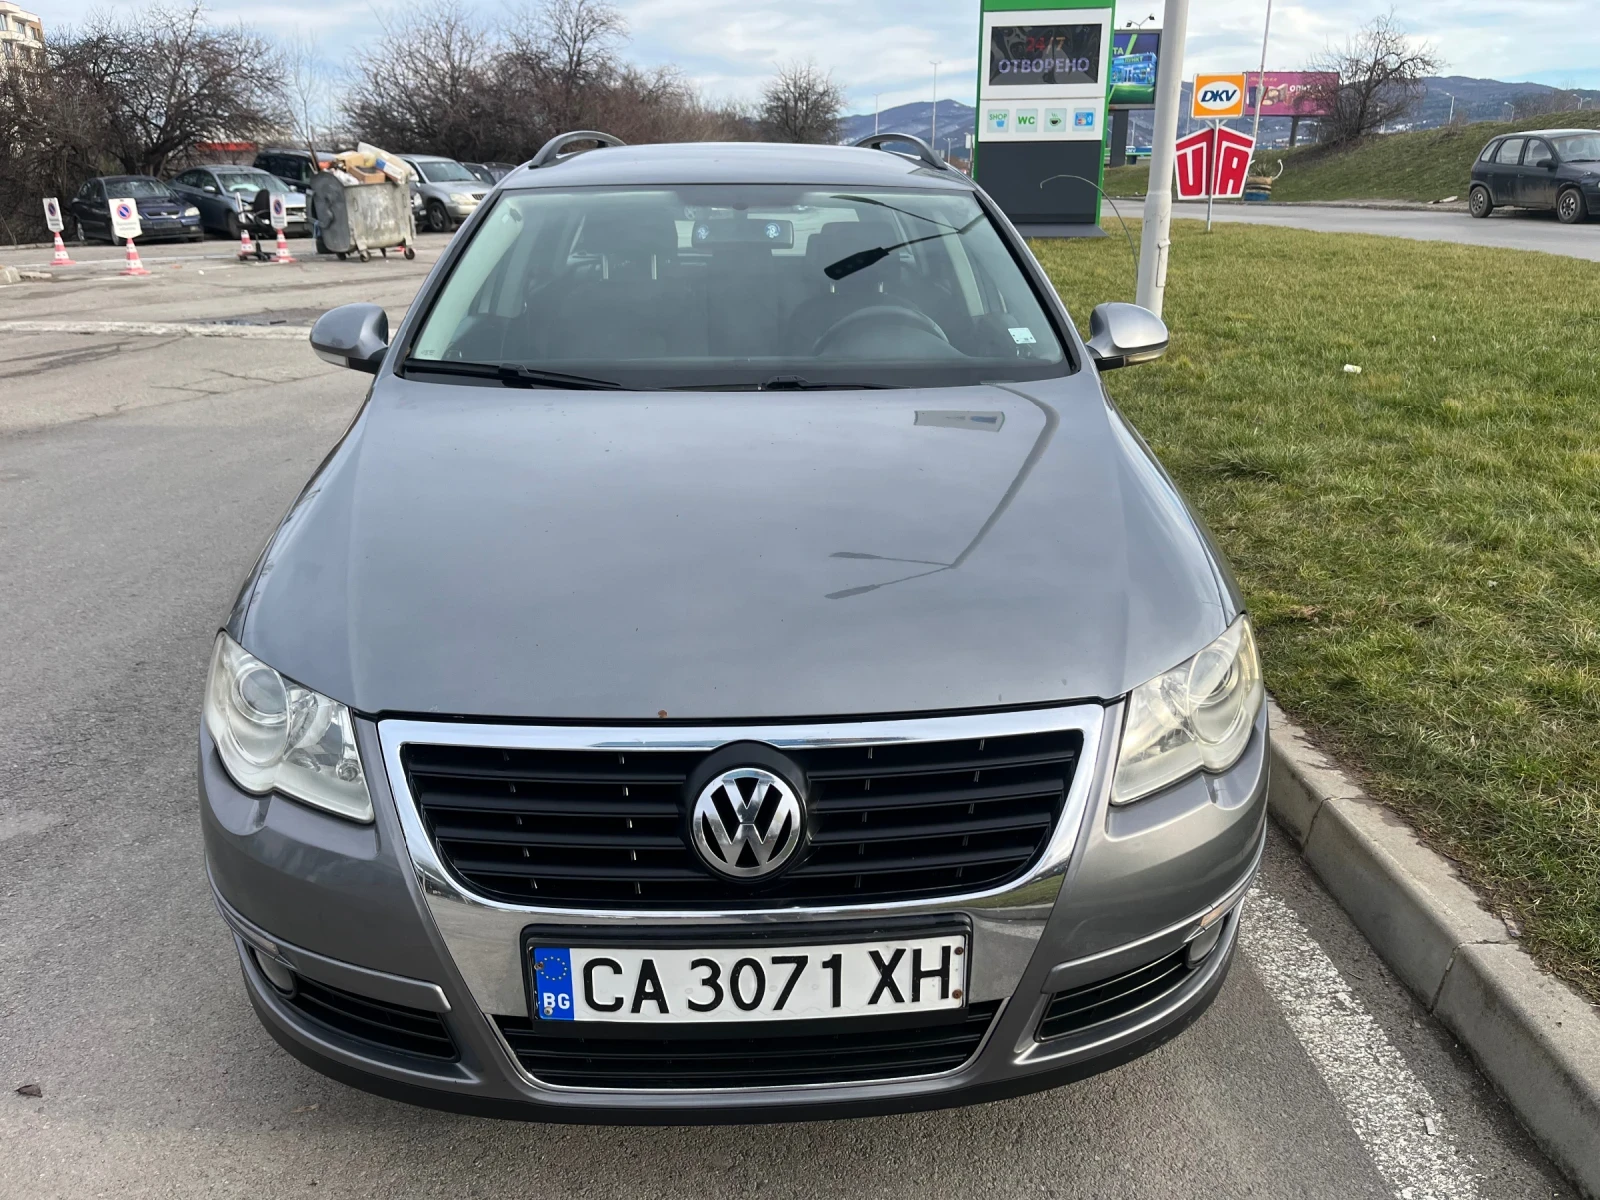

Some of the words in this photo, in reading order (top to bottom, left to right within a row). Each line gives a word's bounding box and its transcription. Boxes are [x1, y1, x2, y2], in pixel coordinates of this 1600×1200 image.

[998, 57, 1090, 74] ОТВОРЕНО
[1200, 89, 1238, 103] DKV
[989, 113, 1008, 121] SHOP
[1017, 115, 1035, 125] WC
[582, 957, 670, 1014] CA
[687, 953, 843, 1011] 3071
[867, 945, 952, 1005] XH
[543, 992, 570, 1010] BG
